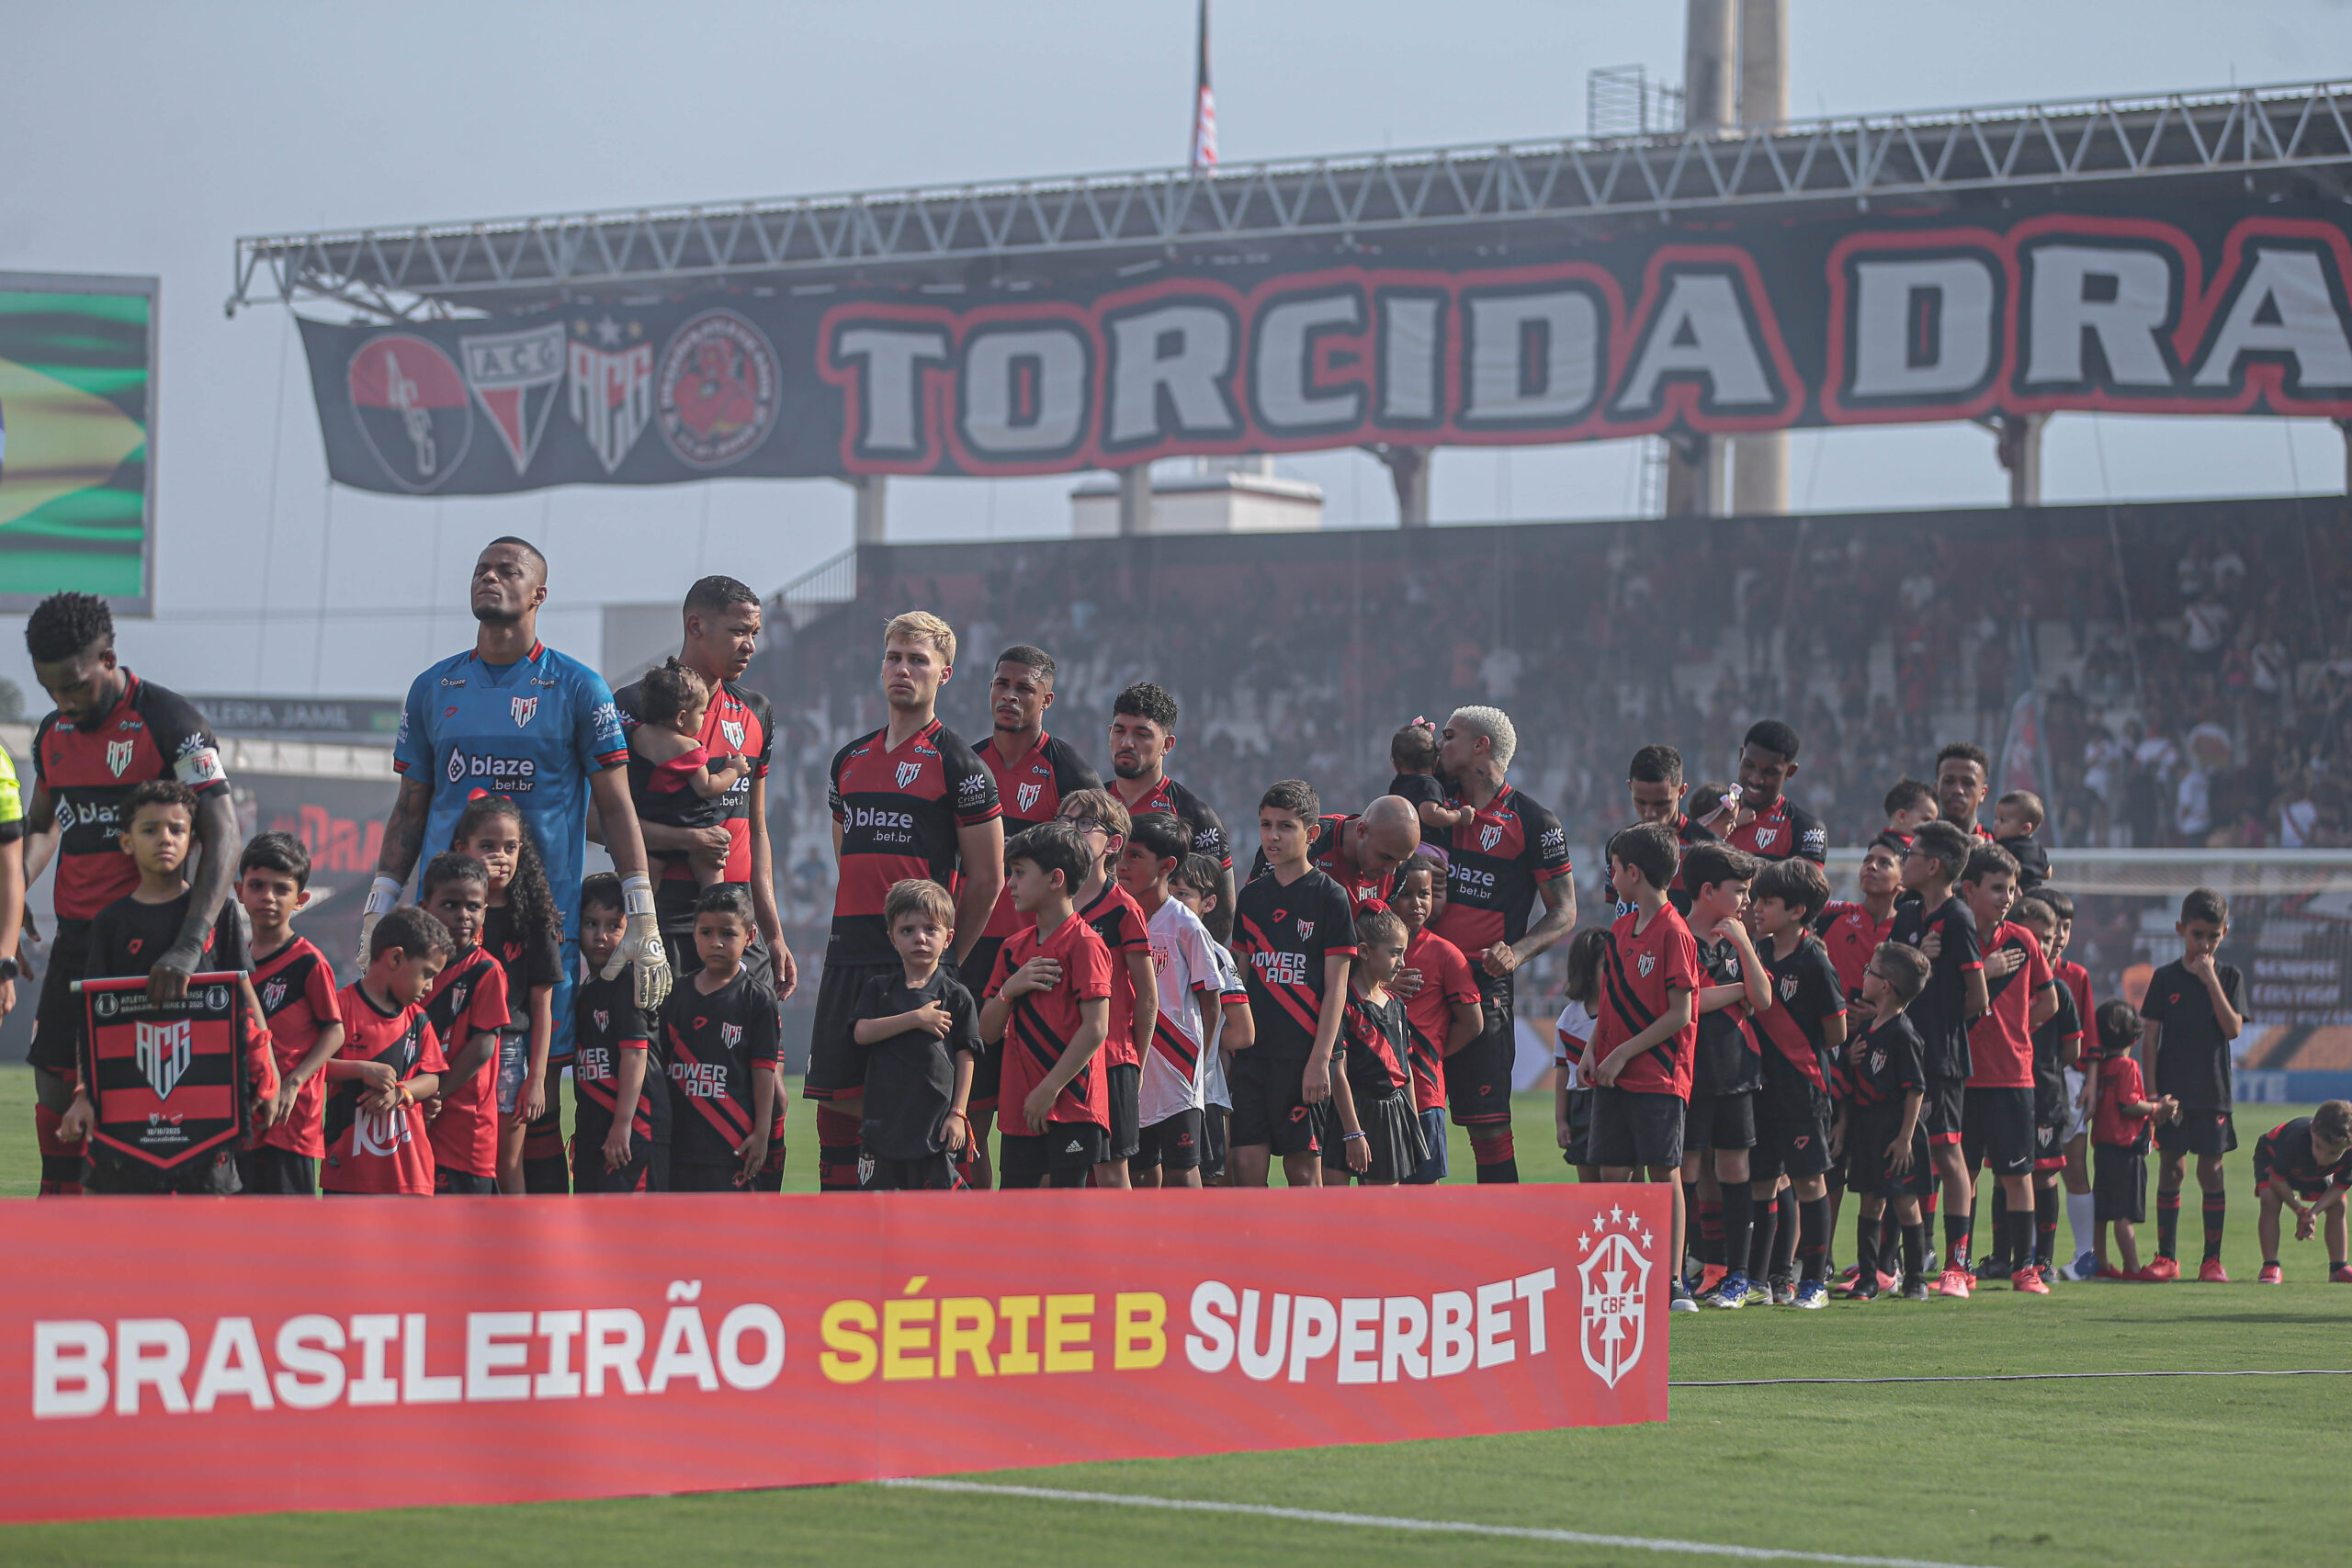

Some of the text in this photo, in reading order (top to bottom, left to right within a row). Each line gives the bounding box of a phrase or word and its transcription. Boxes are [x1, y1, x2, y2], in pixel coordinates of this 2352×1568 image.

[837, 274, 1775, 452] TORCIDA
[1850, 243, 2352, 398] DRA
[470, 755, 535, 776] blaze
[492, 779, 534, 792] .bet.br
[957, 792, 986, 805] Cristal
[77, 802, 119, 823] bla
[855, 807, 913, 829] blaze
[872, 830, 912, 843] .bet.br
[1456, 885, 1492, 900] .bet.br
[1265, 967, 1306, 986] ADE
[136, 1019, 192, 1101] ACG
[576, 1047, 610, 1064] WER
[577, 1063, 611, 1081] ADE
[685, 1079, 726, 1099] ADE
[1600, 1296, 1627, 1314] CBF
[30, 1266, 1556, 1420] BRASILEIRÃO SÉRIE B SUPERBET
